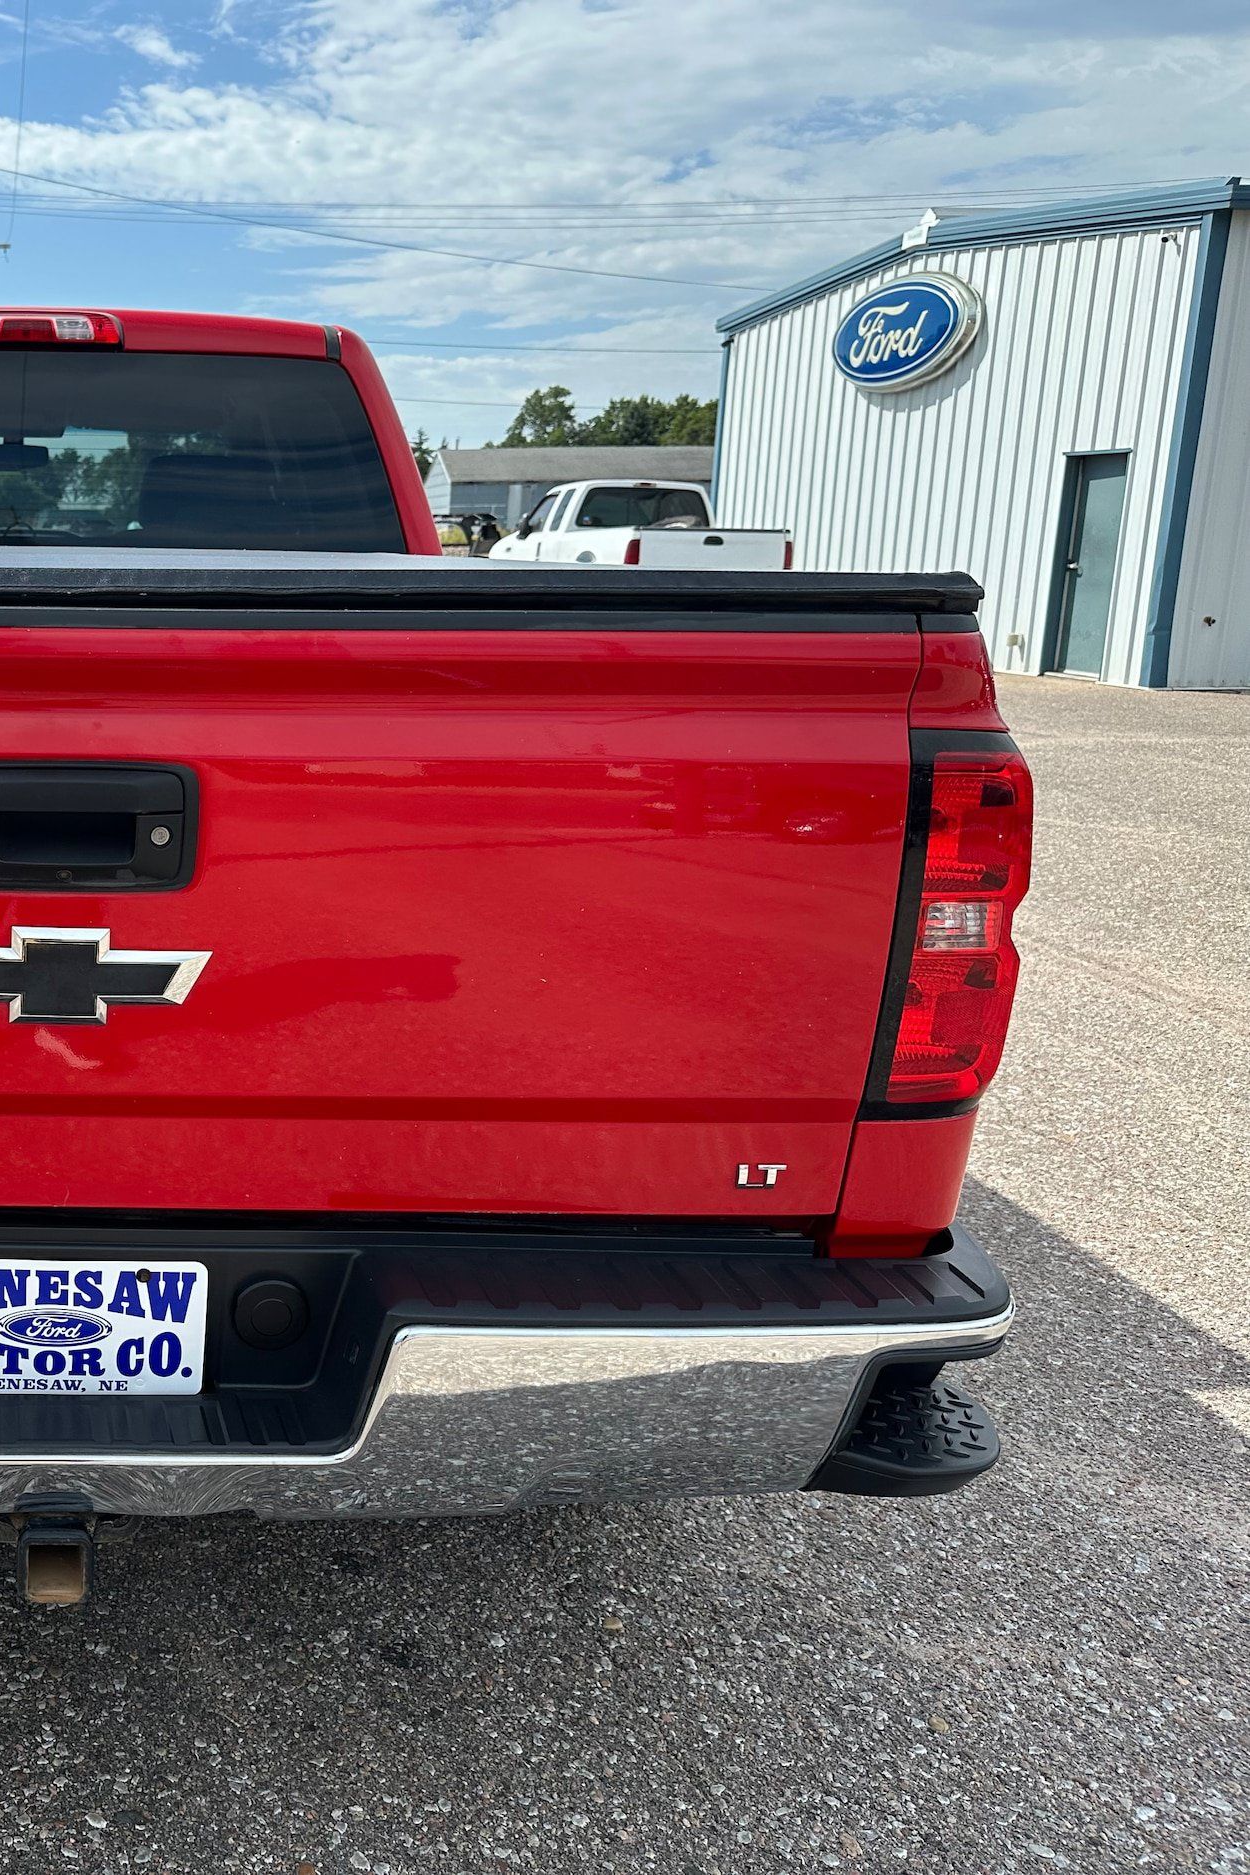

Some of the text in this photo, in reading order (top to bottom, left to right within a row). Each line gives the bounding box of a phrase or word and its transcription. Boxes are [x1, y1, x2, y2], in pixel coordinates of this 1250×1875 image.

[849, 301, 929, 369] Ford
[736, 1164, 788, 1189] LT
[25, 1317, 83, 1339] Ford
[116, 1331, 193, 1378] CO.
[98, 1379, 128, 1392] NE
